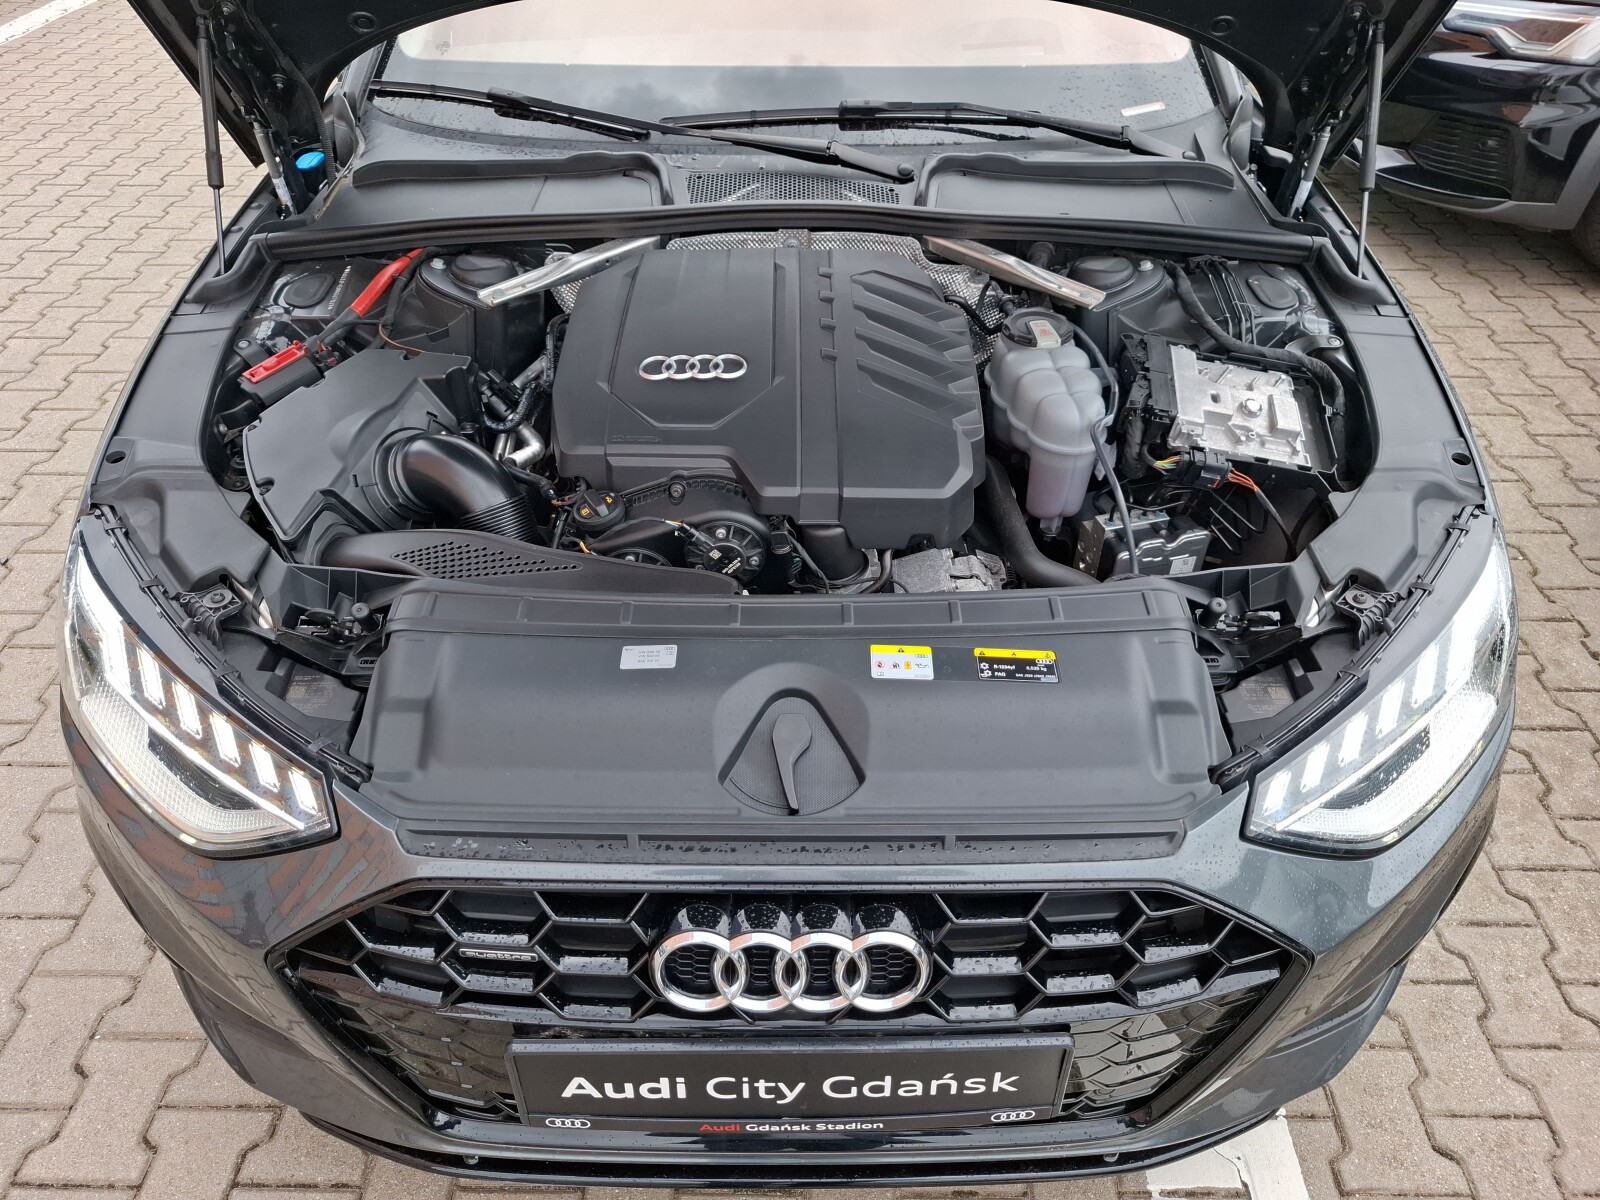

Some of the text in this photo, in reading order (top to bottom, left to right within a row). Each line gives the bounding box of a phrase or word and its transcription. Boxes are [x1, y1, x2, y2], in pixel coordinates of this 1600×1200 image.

[464, 950, 532, 961] quattro
[561, 1071, 1020, 1105] Audi City Gdańsk
[700, 1122, 885, 1132] Audi Gdańsk Stadion
